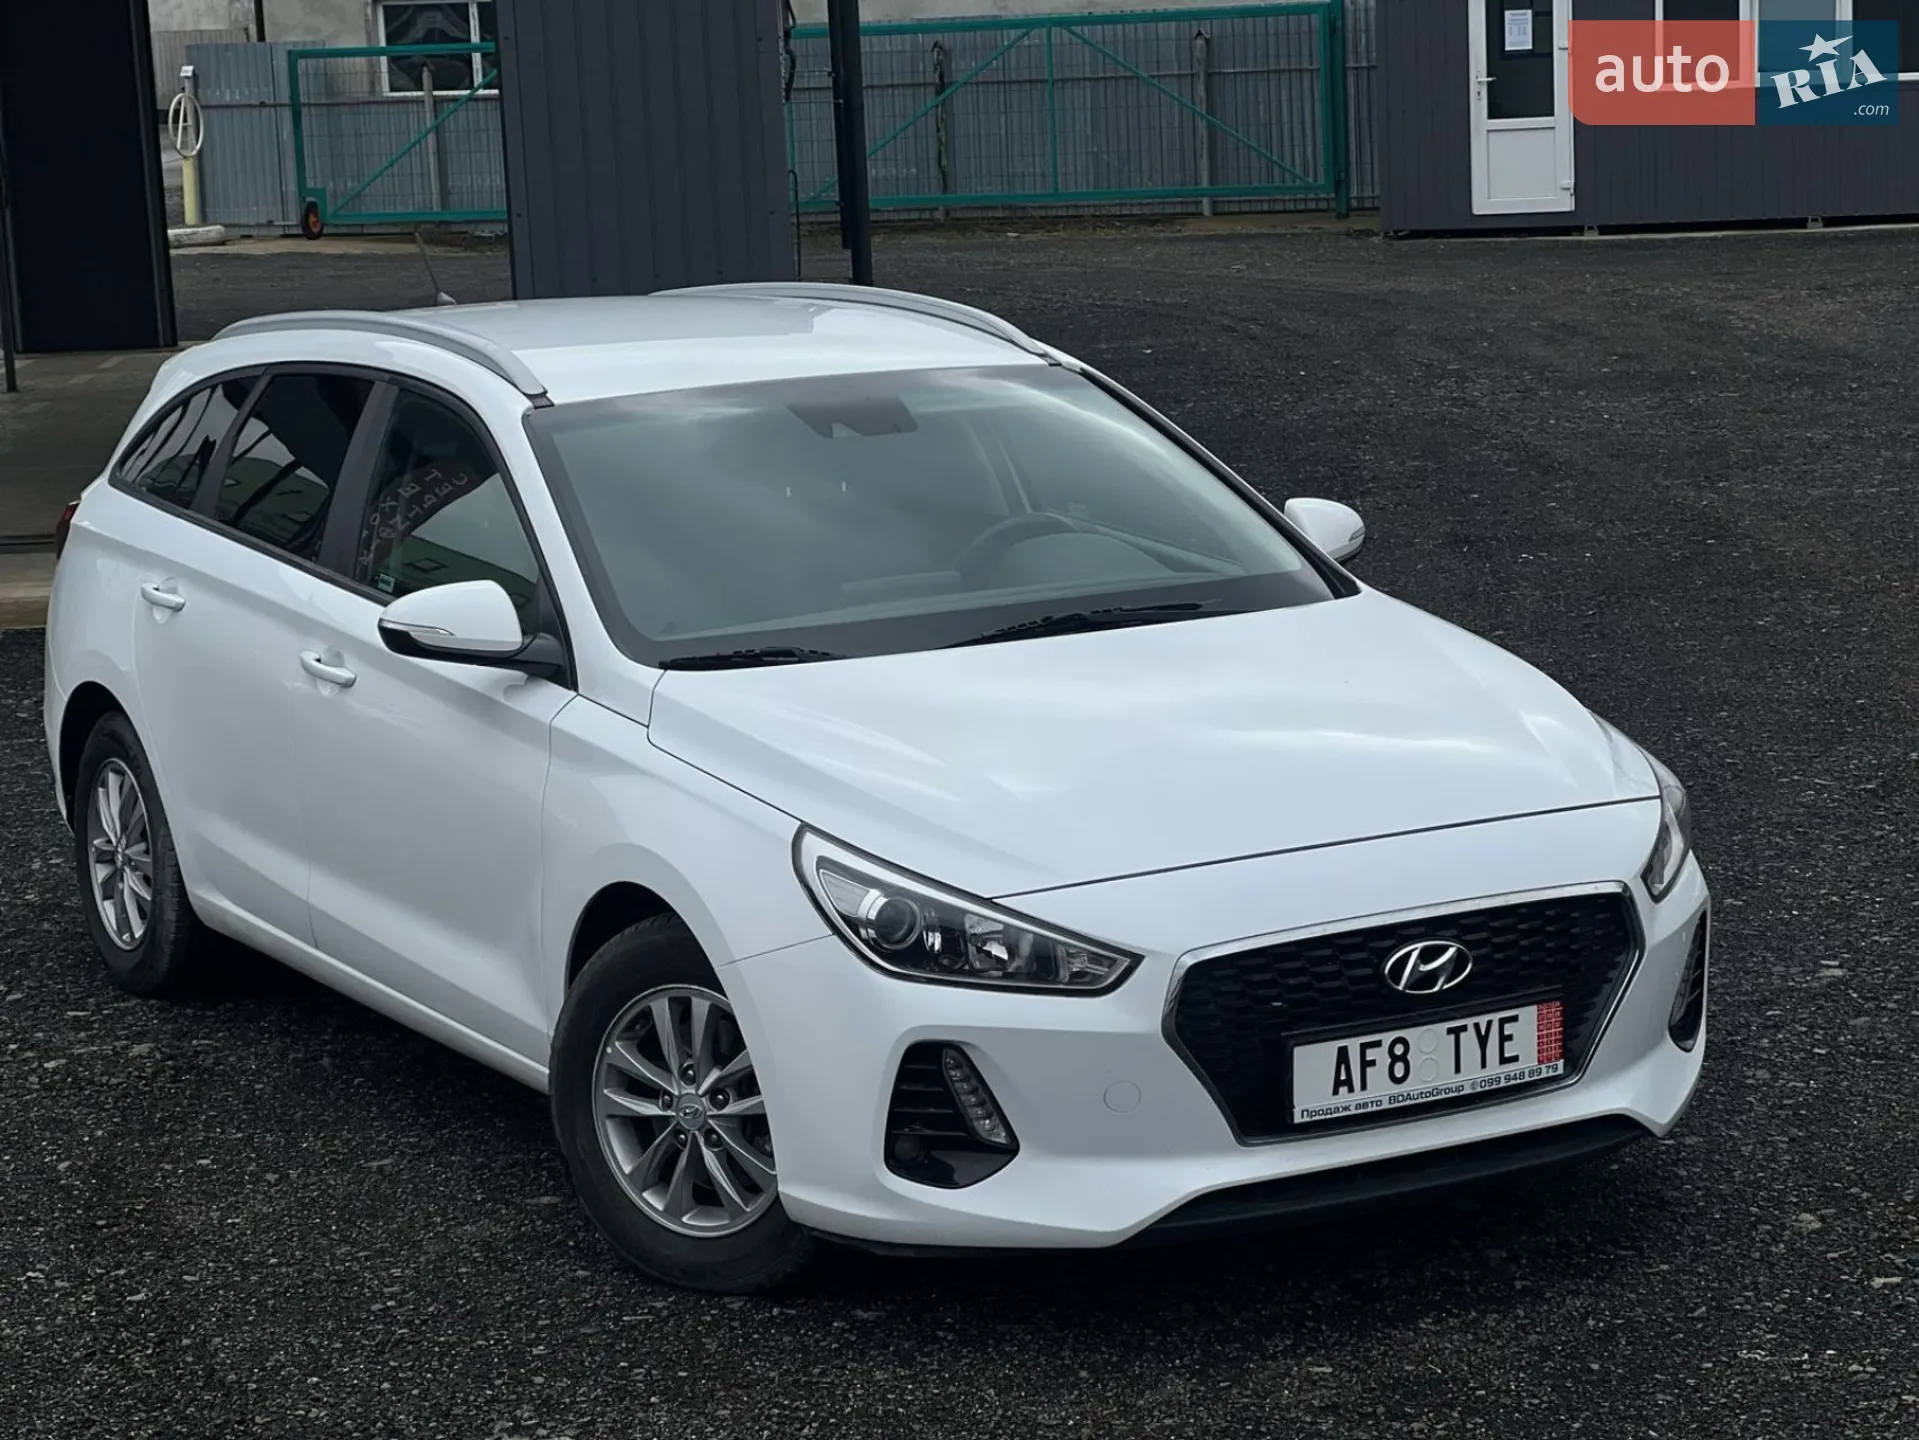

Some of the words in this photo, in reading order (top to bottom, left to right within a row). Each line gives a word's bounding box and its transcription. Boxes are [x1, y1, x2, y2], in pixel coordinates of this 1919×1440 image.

[1331, 1035, 1411, 1097] AF8
[1446, 1013, 1520, 1075] TYE
[1300, 1104, 1352, 1120] Продаж
[1354, 1099, 1383, 1111] авто
[1387, 1083, 1465, 1106] BDAutoGroup
[1479, 1076, 1502, 1089] 099
[1503, 1071, 1526, 1084] 948
[1527, 1067, 1543, 1078] 89
[1545, 1062, 1559, 1074] 79
